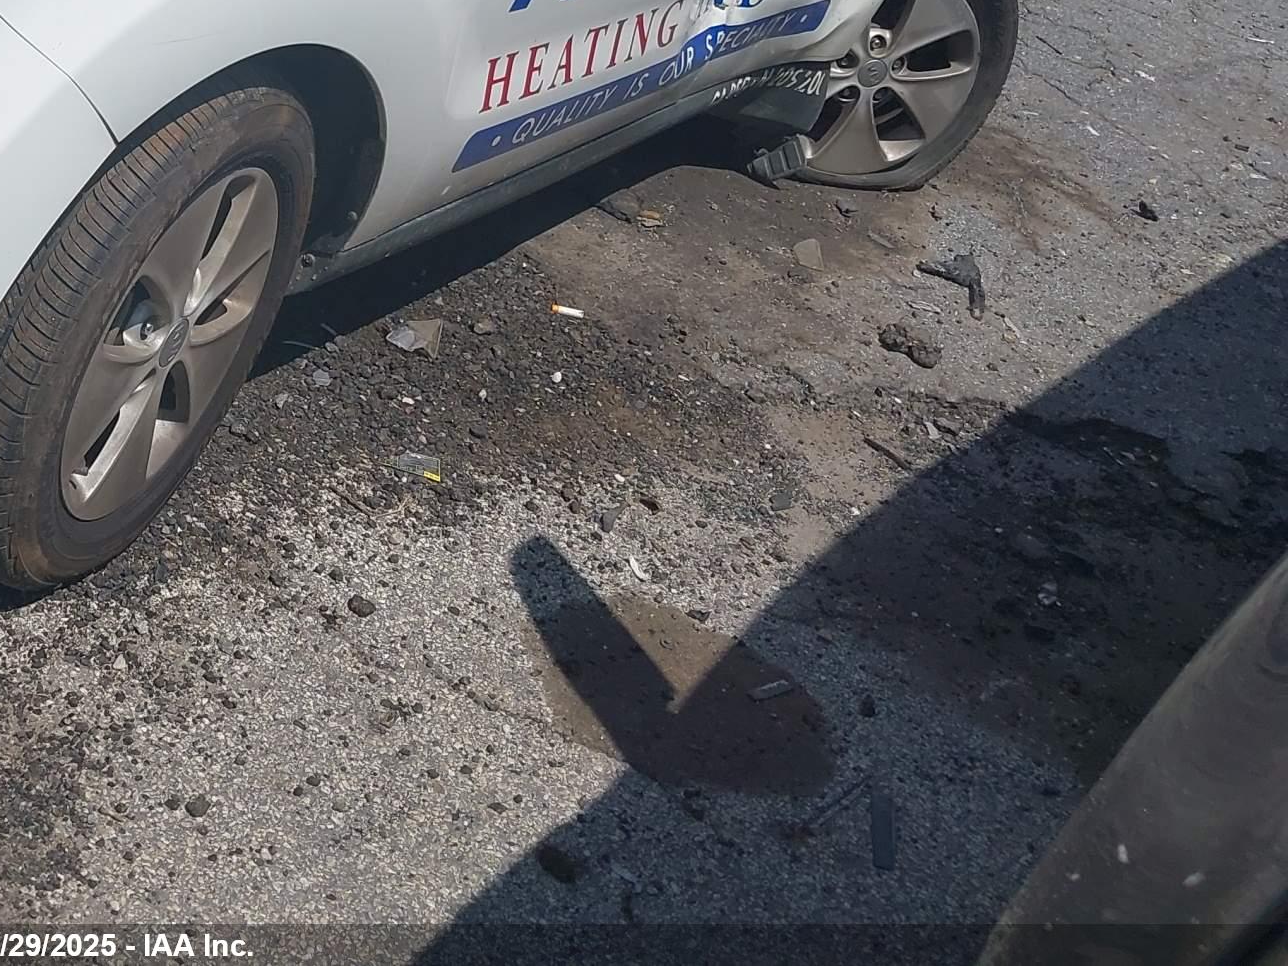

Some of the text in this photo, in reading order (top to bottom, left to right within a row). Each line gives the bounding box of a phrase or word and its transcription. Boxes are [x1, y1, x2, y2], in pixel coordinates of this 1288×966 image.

[512, 84, 619, 144] QUALITY
[622, 72, 650, 101] IS
[658, 46, 695, 86] OUR
